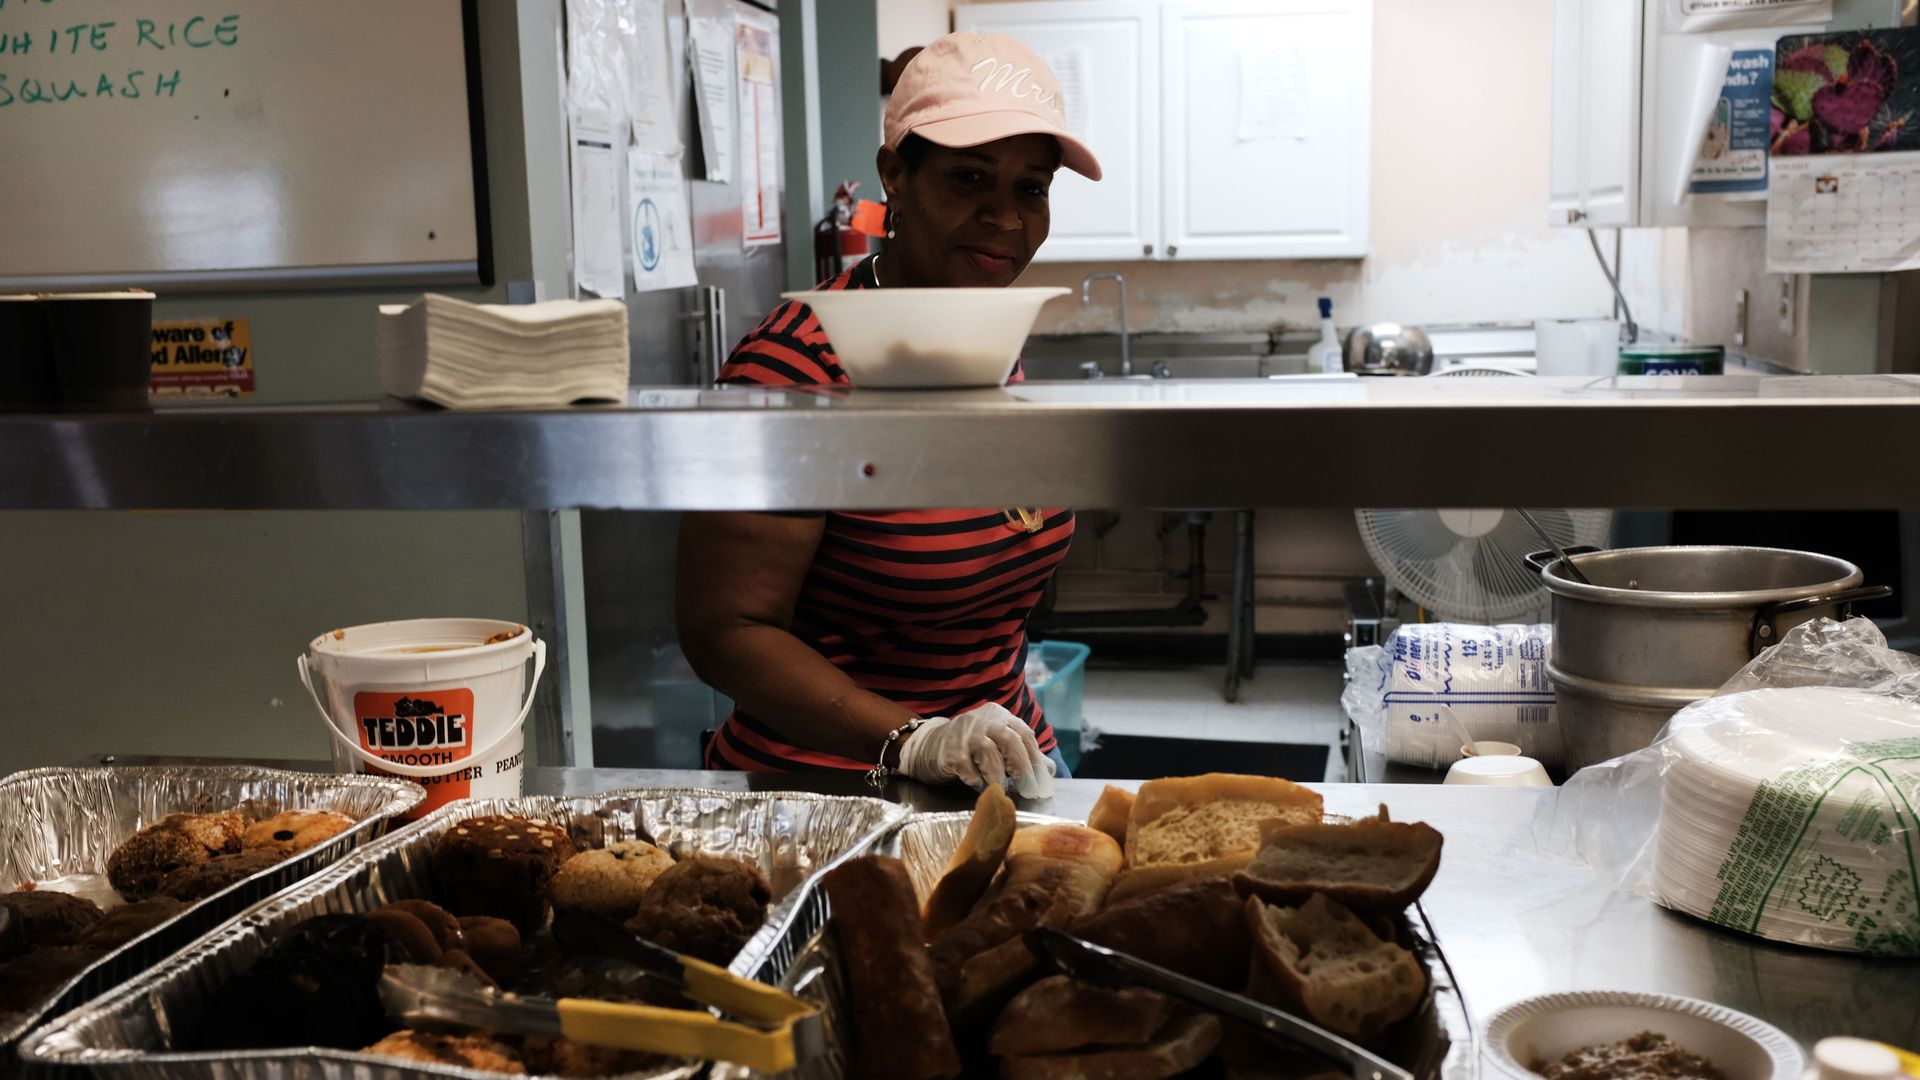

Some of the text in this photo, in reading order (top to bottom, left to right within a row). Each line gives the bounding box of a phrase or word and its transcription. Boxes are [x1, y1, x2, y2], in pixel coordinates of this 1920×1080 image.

[136, 15, 240, 49] RICE
[1730, 55, 1769, 69] wash
[0, 70, 181, 106] SQUASH
[151, 321, 234, 342] ware of
[174, 345, 247, 368] Allergy
[1461, 639, 1477, 656] 125
[361, 714, 466, 752] TEDDIE
[420, 766, 483, 786] BUTTER
[1764, 787, 1777, 801] DO
[1782, 790, 1802, 816] AWAY
[1757, 799, 1772, 818] NOT
[1768, 806, 1781, 819] TO
[1789, 800, 1810, 826] AVOID
[1736, 823, 1749, 838] OR
[1748, 817, 1763, 835] USE
[1757, 818, 1776, 842] NOSE
[1771, 813, 1790, 839] FROM
[1725, 836, 1743, 860] PLAY
[1739, 834, 1755, 854] THIS
[1749, 840, 1765, 859] AND
[1757, 837, 1779, 866] SMALL
[1773, 824, 1798, 860] DANGER
[1730, 853, 1746, 872] BAG
[1767, 857, 1780, 871] OF
[1725, 871, 1737, 882] IN
[1734, 858, 1756, 889] MOUTH
[1724, 887, 1741, 907] AND
[1739, 869, 1773, 924] SUFFOCATION
